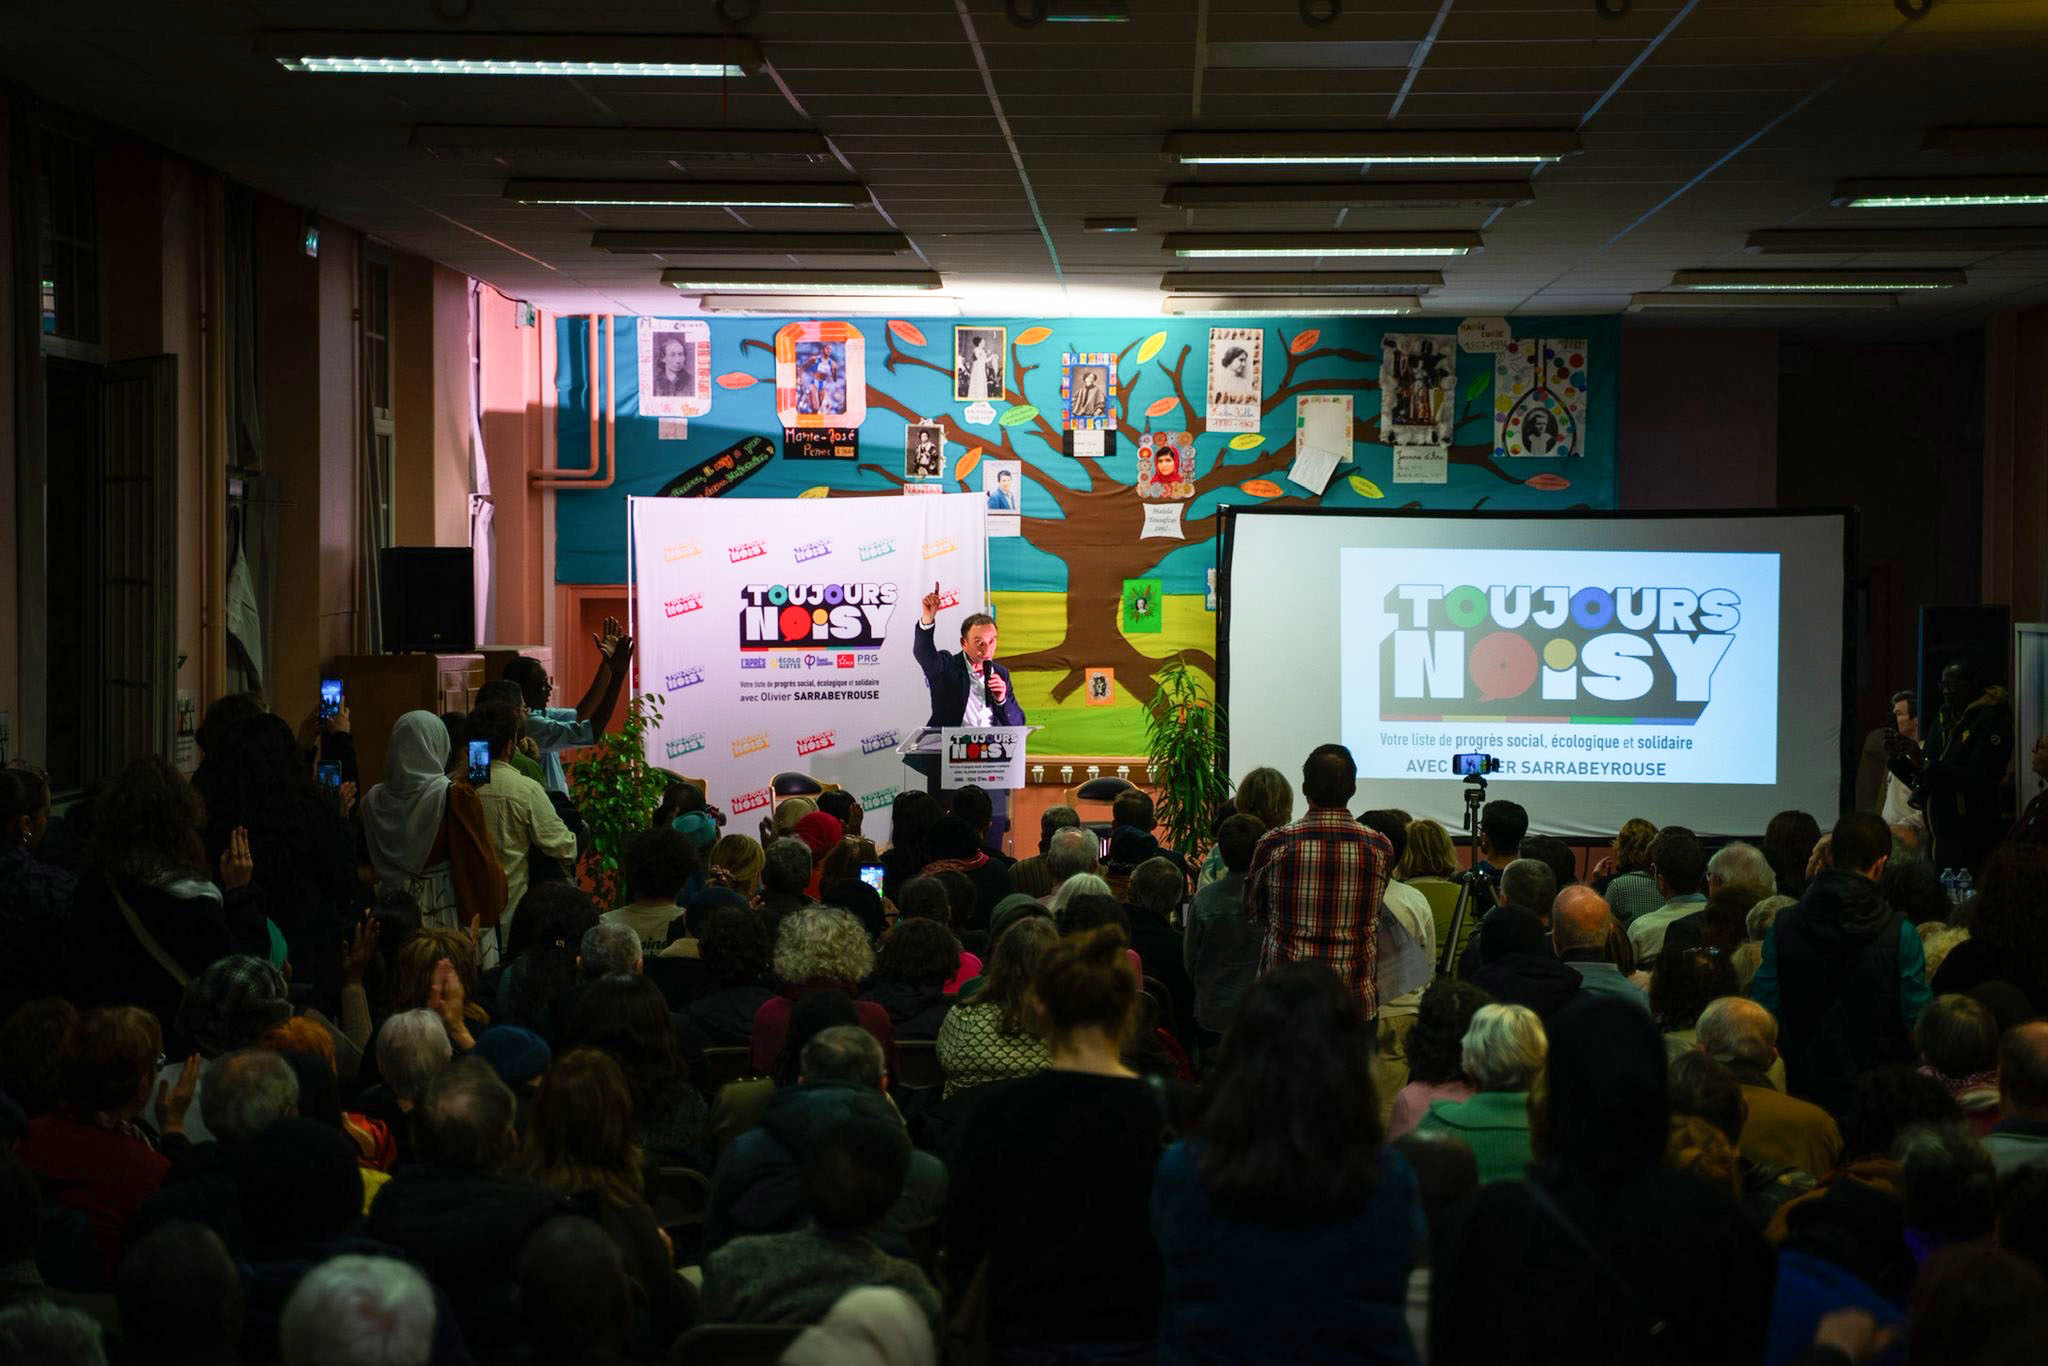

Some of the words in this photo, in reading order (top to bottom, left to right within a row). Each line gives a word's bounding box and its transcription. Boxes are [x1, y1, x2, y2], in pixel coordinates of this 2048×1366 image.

[746, 583, 898, 605] TOUJOURS
[1392, 583, 1741, 632] TOUJOURS
[774, 680, 796, 689] progrès
[817, 679, 847, 689] écologique
[855, 678, 880, 686] solidaire
[740, 694, 758, 702] avec
[760, 692, 791, 701] Olivier
[794, 690, 880, 700] SARRABEYROUSE
[952, 733, 1018, 744] TOUJOURS
[1380, 732, 1408, 746] Votre
[1411, 733, 1436, 746] liste
[1439, 734, 1452, 746] de
[1455, 733, 1503, 750] progrès
[1506, 733, 1547, 749] social,
[1551, 734, 1620, 751] écologique
[1623, 738, 1634, 749] et
[1637, 735, 1693, 750] solidaire
[1406, 759, 1448, 773] AVEC
[1521, 761, 1667, 776] SARRABEYROUSE
